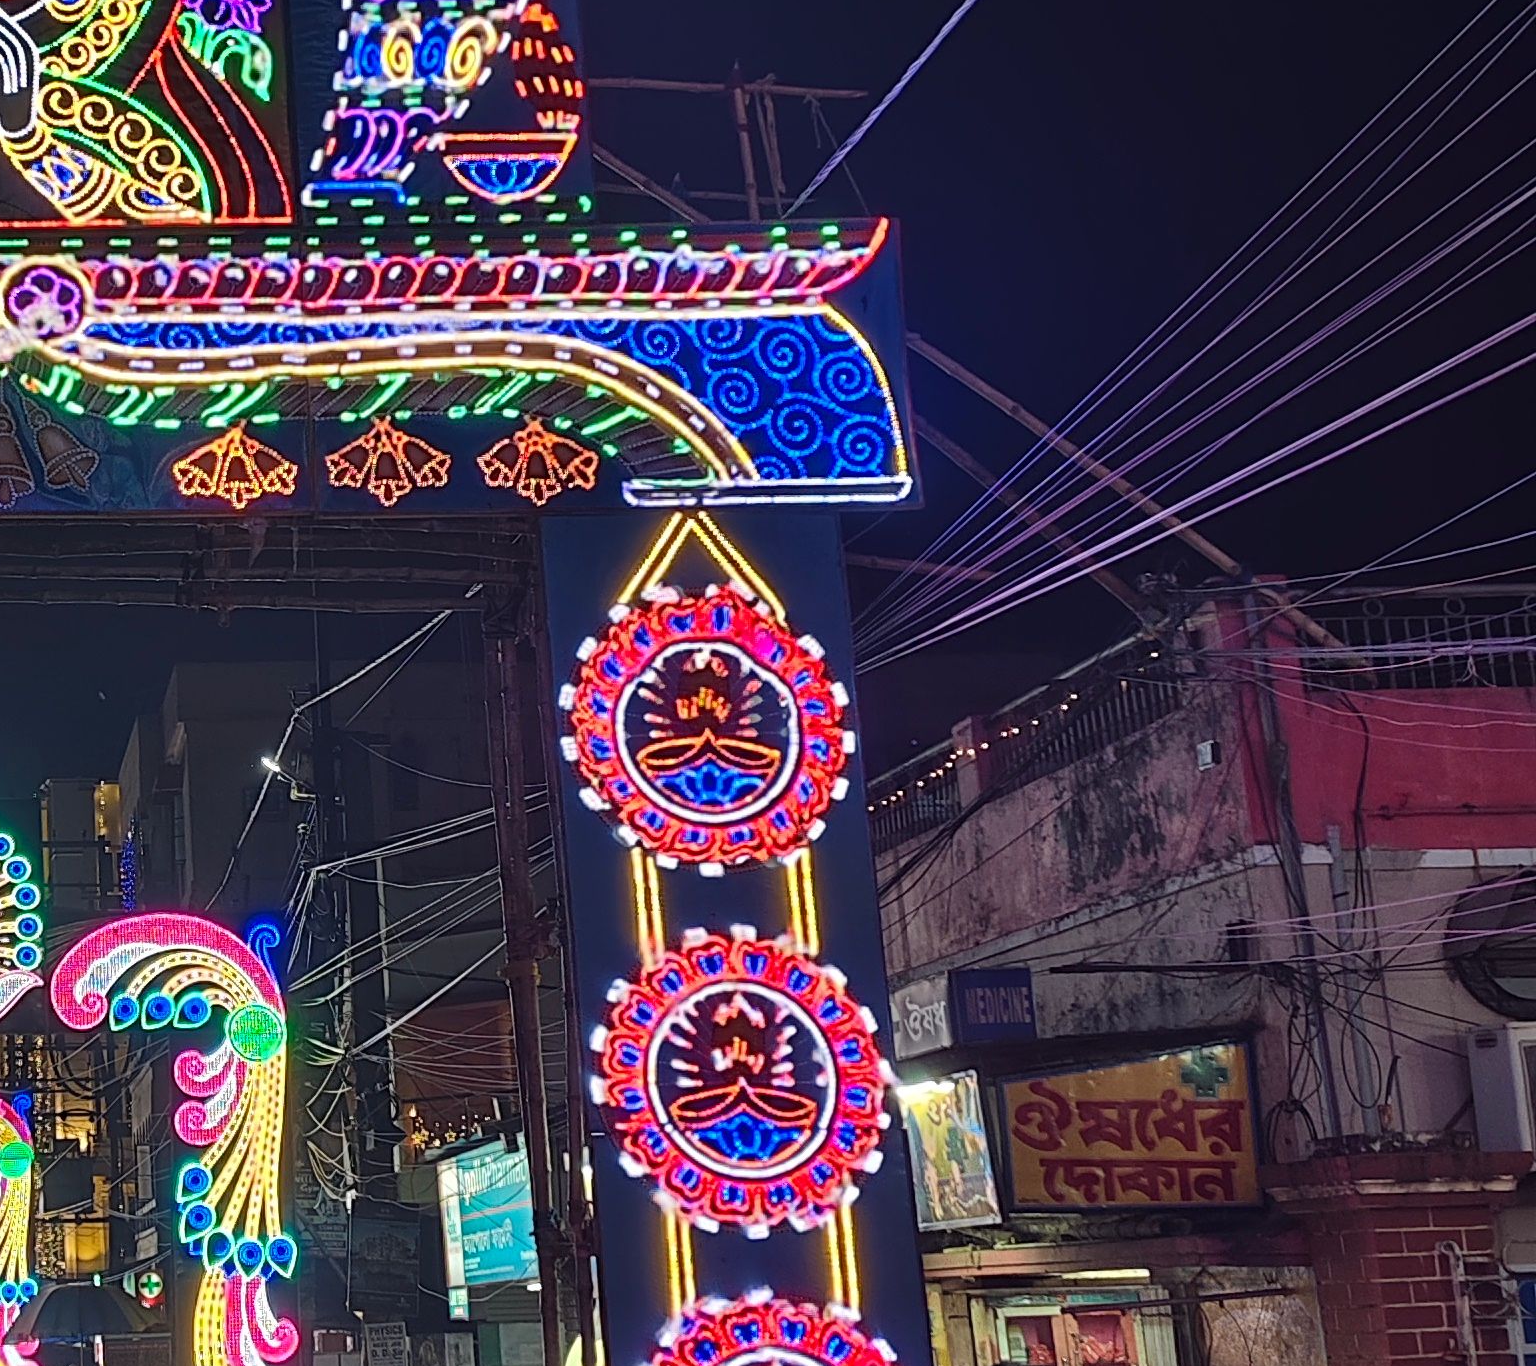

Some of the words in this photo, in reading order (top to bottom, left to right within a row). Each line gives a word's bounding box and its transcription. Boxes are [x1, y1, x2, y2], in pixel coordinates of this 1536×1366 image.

[904, 996, 947, 1041] ঔষধ
[965, 986, 1032, 1024] MEDICINE
[1013, 1081, 1247, 1156] ঔষধের
[1039, 1159, 1239, 1204] দোকান
